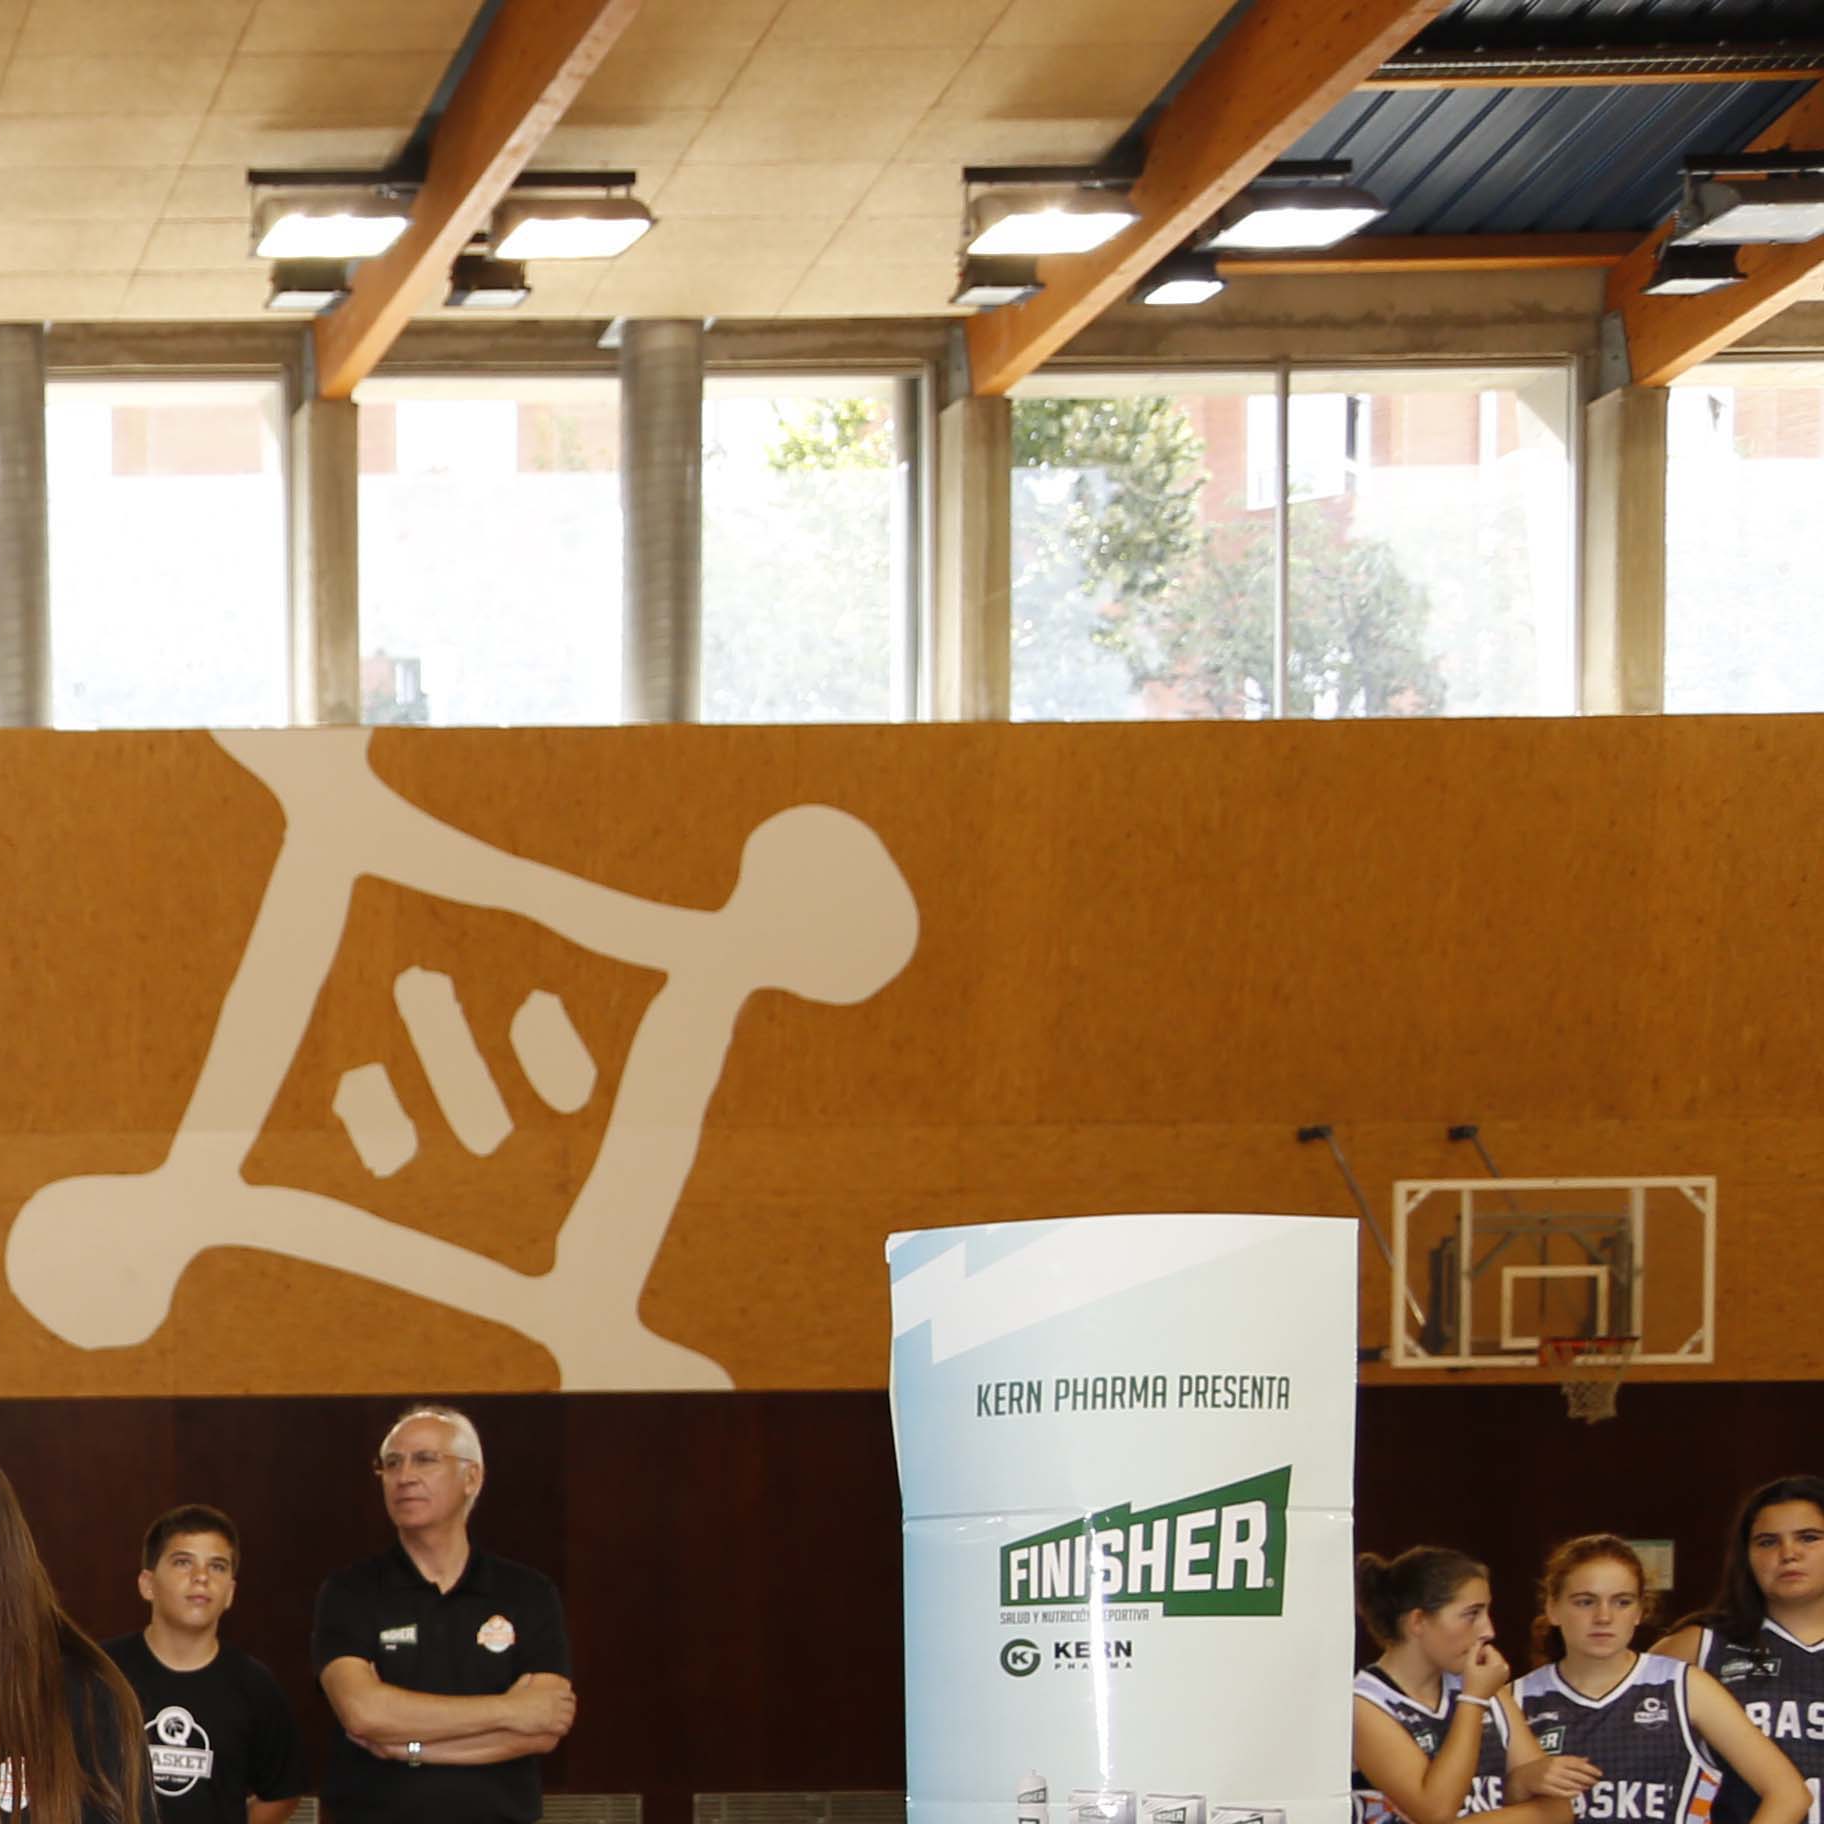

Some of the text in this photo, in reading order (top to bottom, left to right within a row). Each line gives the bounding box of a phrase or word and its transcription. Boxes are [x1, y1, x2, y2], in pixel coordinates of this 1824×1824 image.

[976, 1375, 1290, 1417] KERN PHARMA PRESENTA
[1000, 1611, 1039, 1624] SALUD Y
